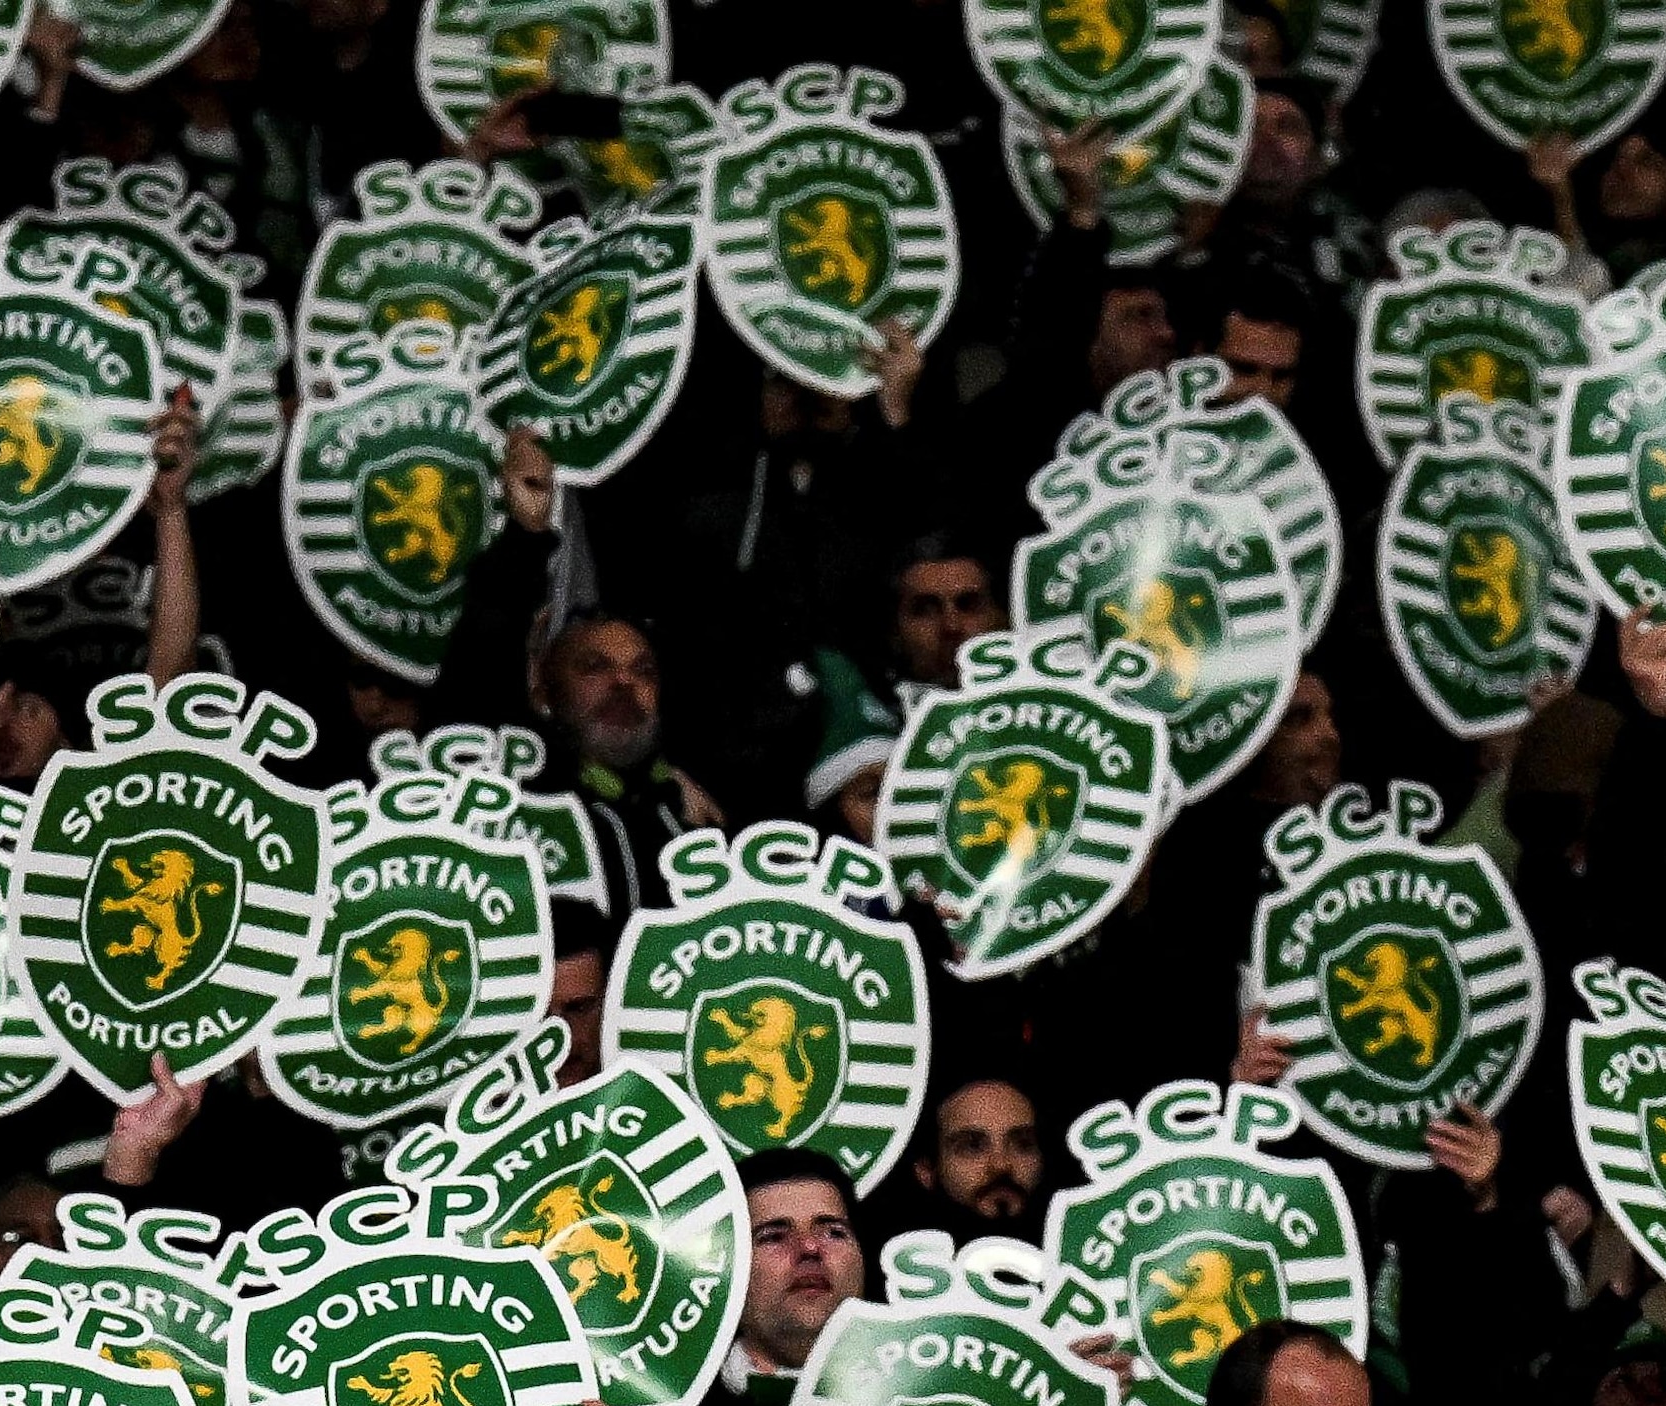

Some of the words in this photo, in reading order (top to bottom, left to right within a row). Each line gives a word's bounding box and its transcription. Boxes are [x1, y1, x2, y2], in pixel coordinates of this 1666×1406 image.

[723, 71, 897, 135] SCP
[66, 167, 227, 244] SCP
[367, 167, 529, 222] SCP
[729, 140, 918, 213] SPORTING
[1393, 226, 1561, 280] SCP
[1032, 435, 1220, 522] SCP
[966, 635, 1153, 691] SCP
[95, 682, 313, 759] SCP
[382, 734, 531, 775] SCP
[925, 700, 1134, 781] SPORTING
[57, 769, 293, 877] SPORTING
[311, 767, 513, 851] SCP
[1264, 785, 1447, 879] SCP
[667, 832, 888, 901] SCP
[1280, 868, 1480, 971] SPORTING
[646, 917, 892, 1012] SPORTING
[41, 978, 247, 1052] PORTUGAL
[306, 1052, 500, 1122] PORTUGAL
[397, 1027, 564, 1179] SCP
[1073, 1084, 1294, 1174] SCP
[250, 1181, 492, 1282] SCP
[1080, 1175, 1320, 1272] SPORTING
[268, 1270, 536, 1384] SPORTING
[893, 1235, 1110, 1337] SCP
